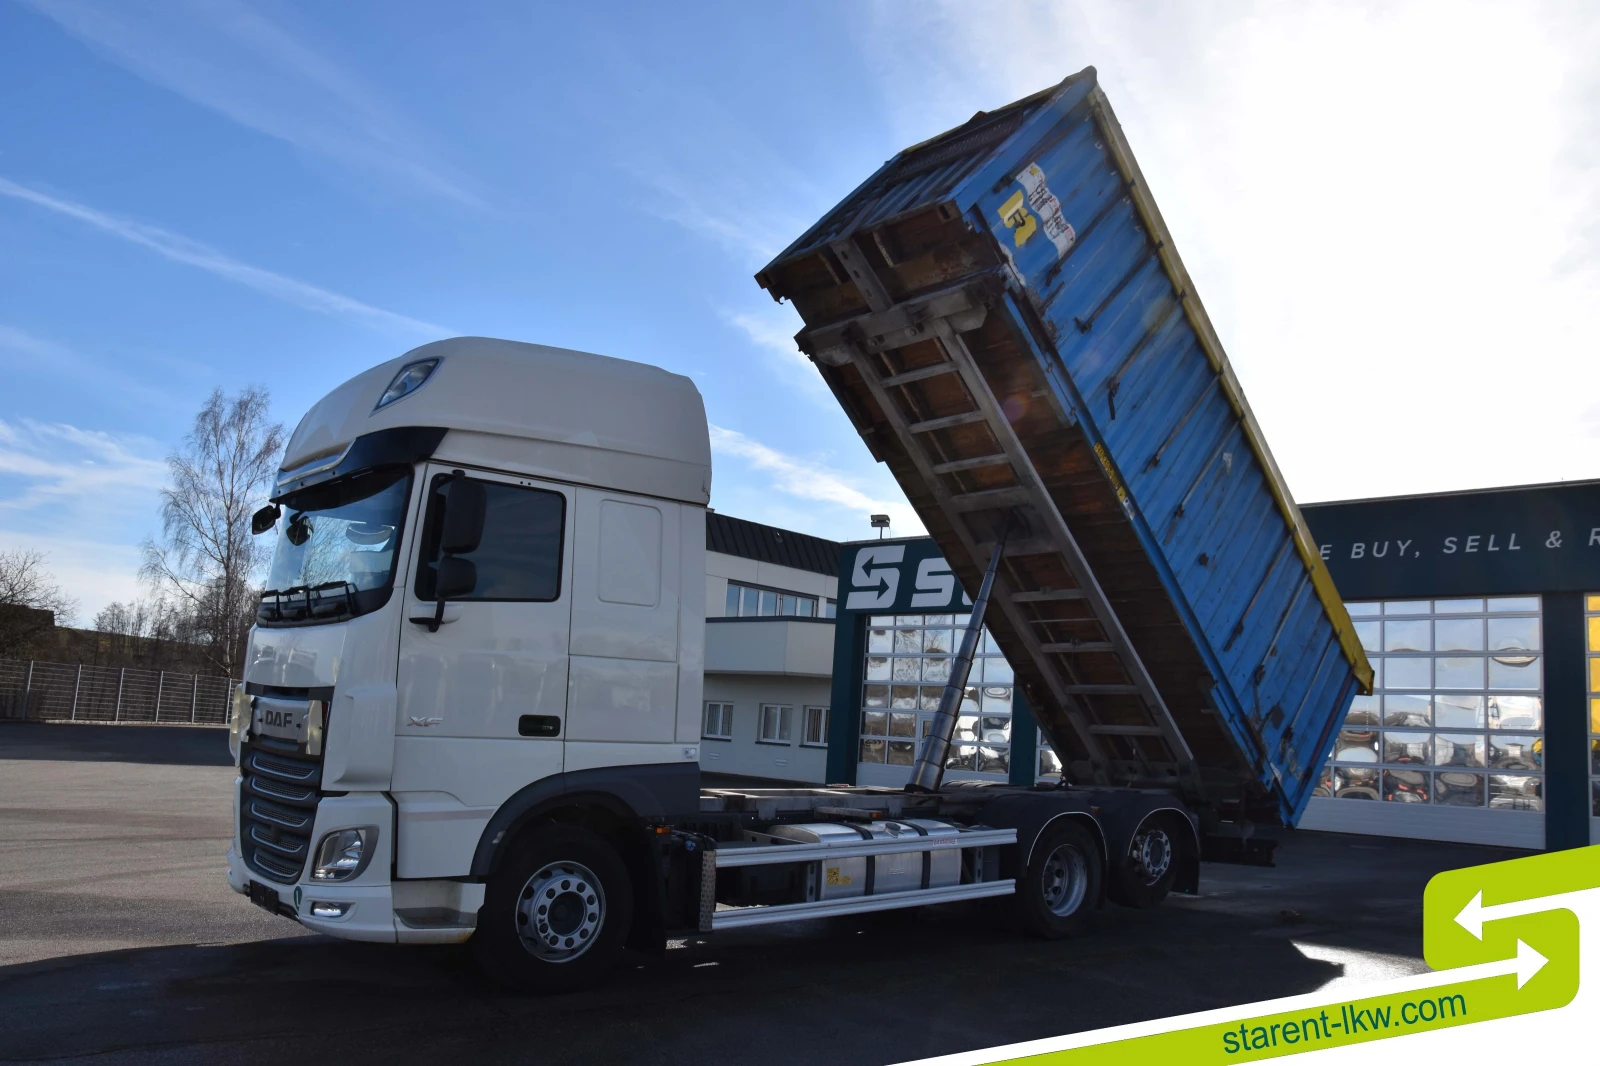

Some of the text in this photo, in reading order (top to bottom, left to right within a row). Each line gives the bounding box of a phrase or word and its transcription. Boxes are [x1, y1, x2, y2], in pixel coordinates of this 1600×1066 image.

[1350, 539, 1421, 559] BUY,
[1443, 533, 1521, 554] SELL
[1545, 530, 1564, 549] &
[911, 557, 973, 608] S
[265, 709, 293, 728] DAF
[406, 715, 444, 727] XF
